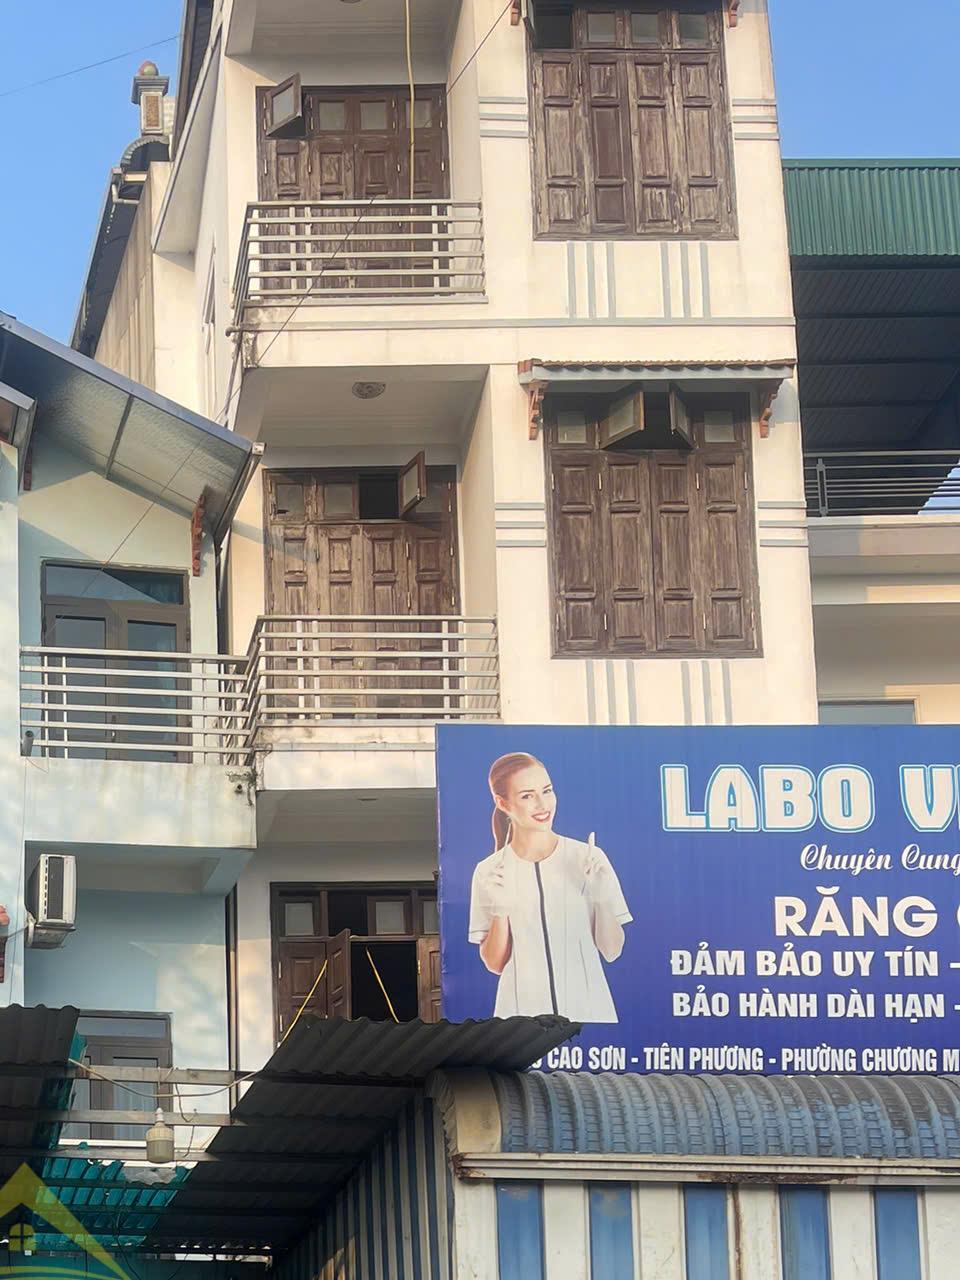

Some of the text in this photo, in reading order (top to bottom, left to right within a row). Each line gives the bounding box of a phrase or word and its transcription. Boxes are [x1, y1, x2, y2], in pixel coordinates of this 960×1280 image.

[660, 764, 960, 833] LABO V
[800, 843, 893, 876] Chuyên
[774, 885, 939, 938] RĂNG
[670, 941, 745, 976] ĐẢM
[756, 942, 822, 977] BẢO
[832, 951, 874, 977] UY
[884, 945, 939, 977] TÍN
[672, 984, 730, 1018] BẢO
[739, 987, 818, 1018] HÀNH
[827, 987, 875, 1018] DÀI
[885, 993, 945, 1024] HẠN
[547, 1046, 583, 1070] CAO
[588, 1044, 626, 1071] SƠN
[643, 1042, 685, 1071] TIÊN
[689, 1045, 764, 1072] PHƯƠNG
[781, 1042, 857, 1072] PHƯỜNG
[862, 1046, 938, 1072] CHƯƠNG
